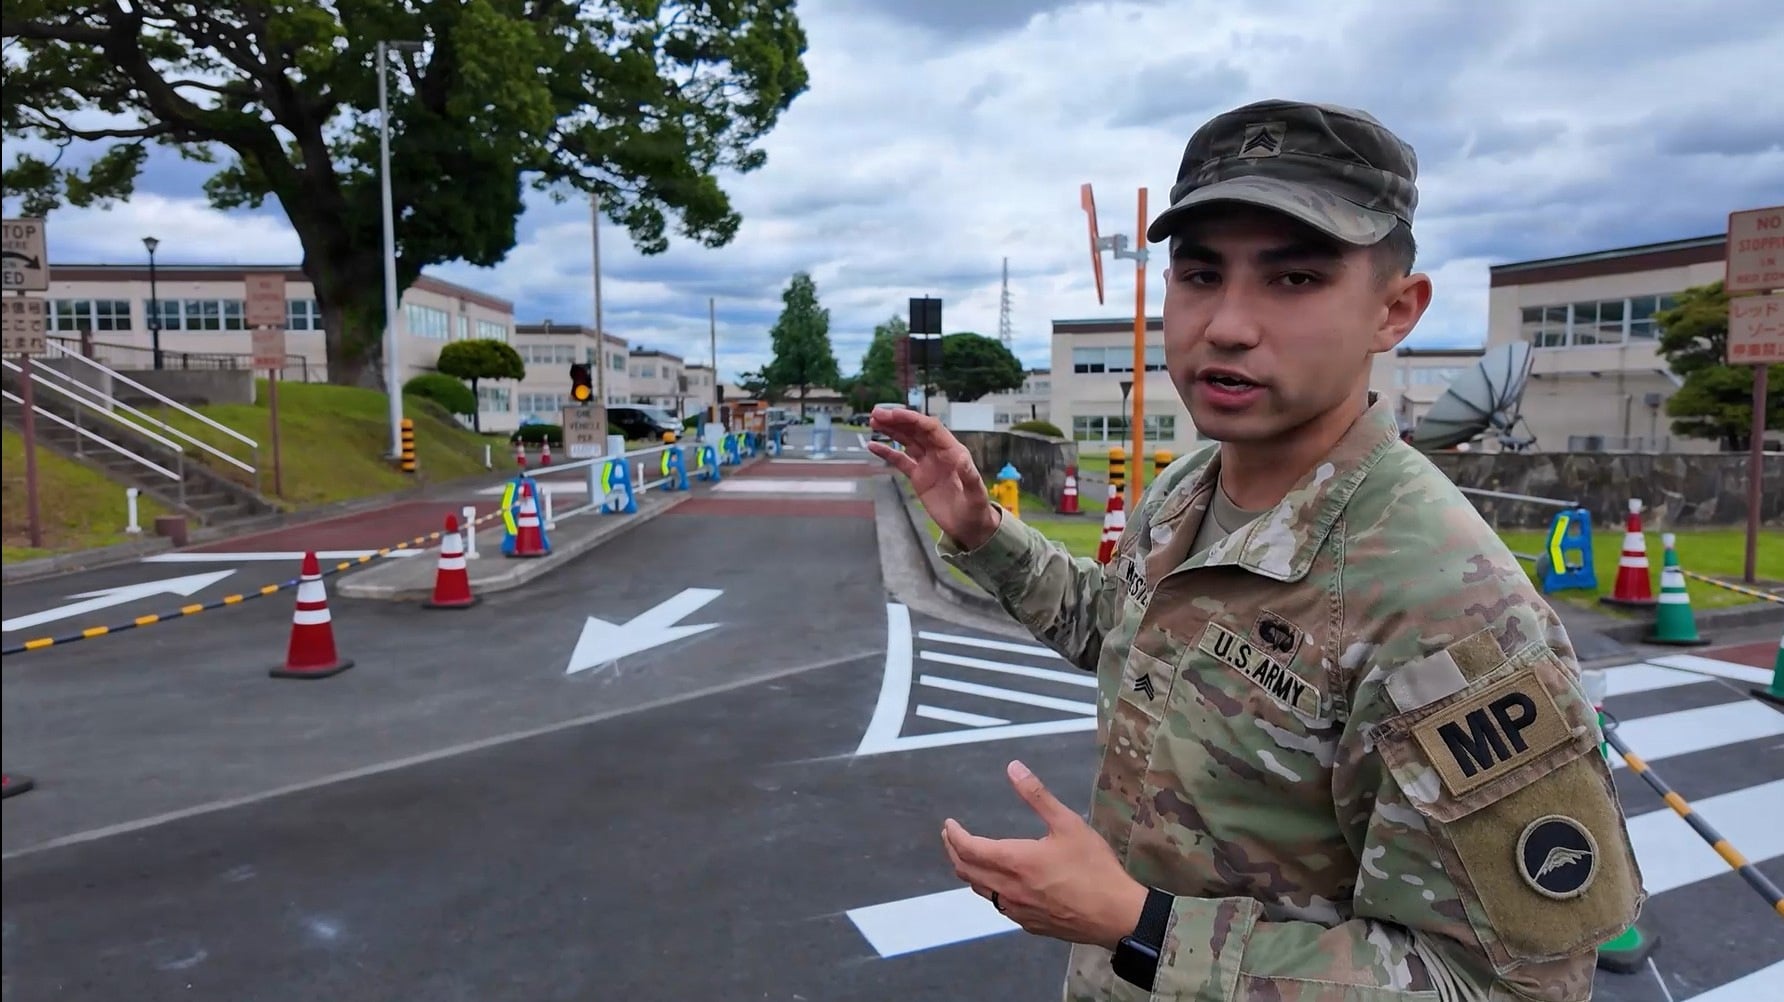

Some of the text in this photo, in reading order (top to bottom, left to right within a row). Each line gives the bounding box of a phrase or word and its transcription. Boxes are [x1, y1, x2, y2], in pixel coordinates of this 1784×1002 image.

[1757, 216, 1781, 231] NO
[3, 224, 37, 239] TOP
[1738, 236, 1784, 252] STOPPI
[3, 271, 25, 285] ED
[1214, 631, 1305, 708] U.S. ARMY
[1437, 692, 1537, 778] MP
